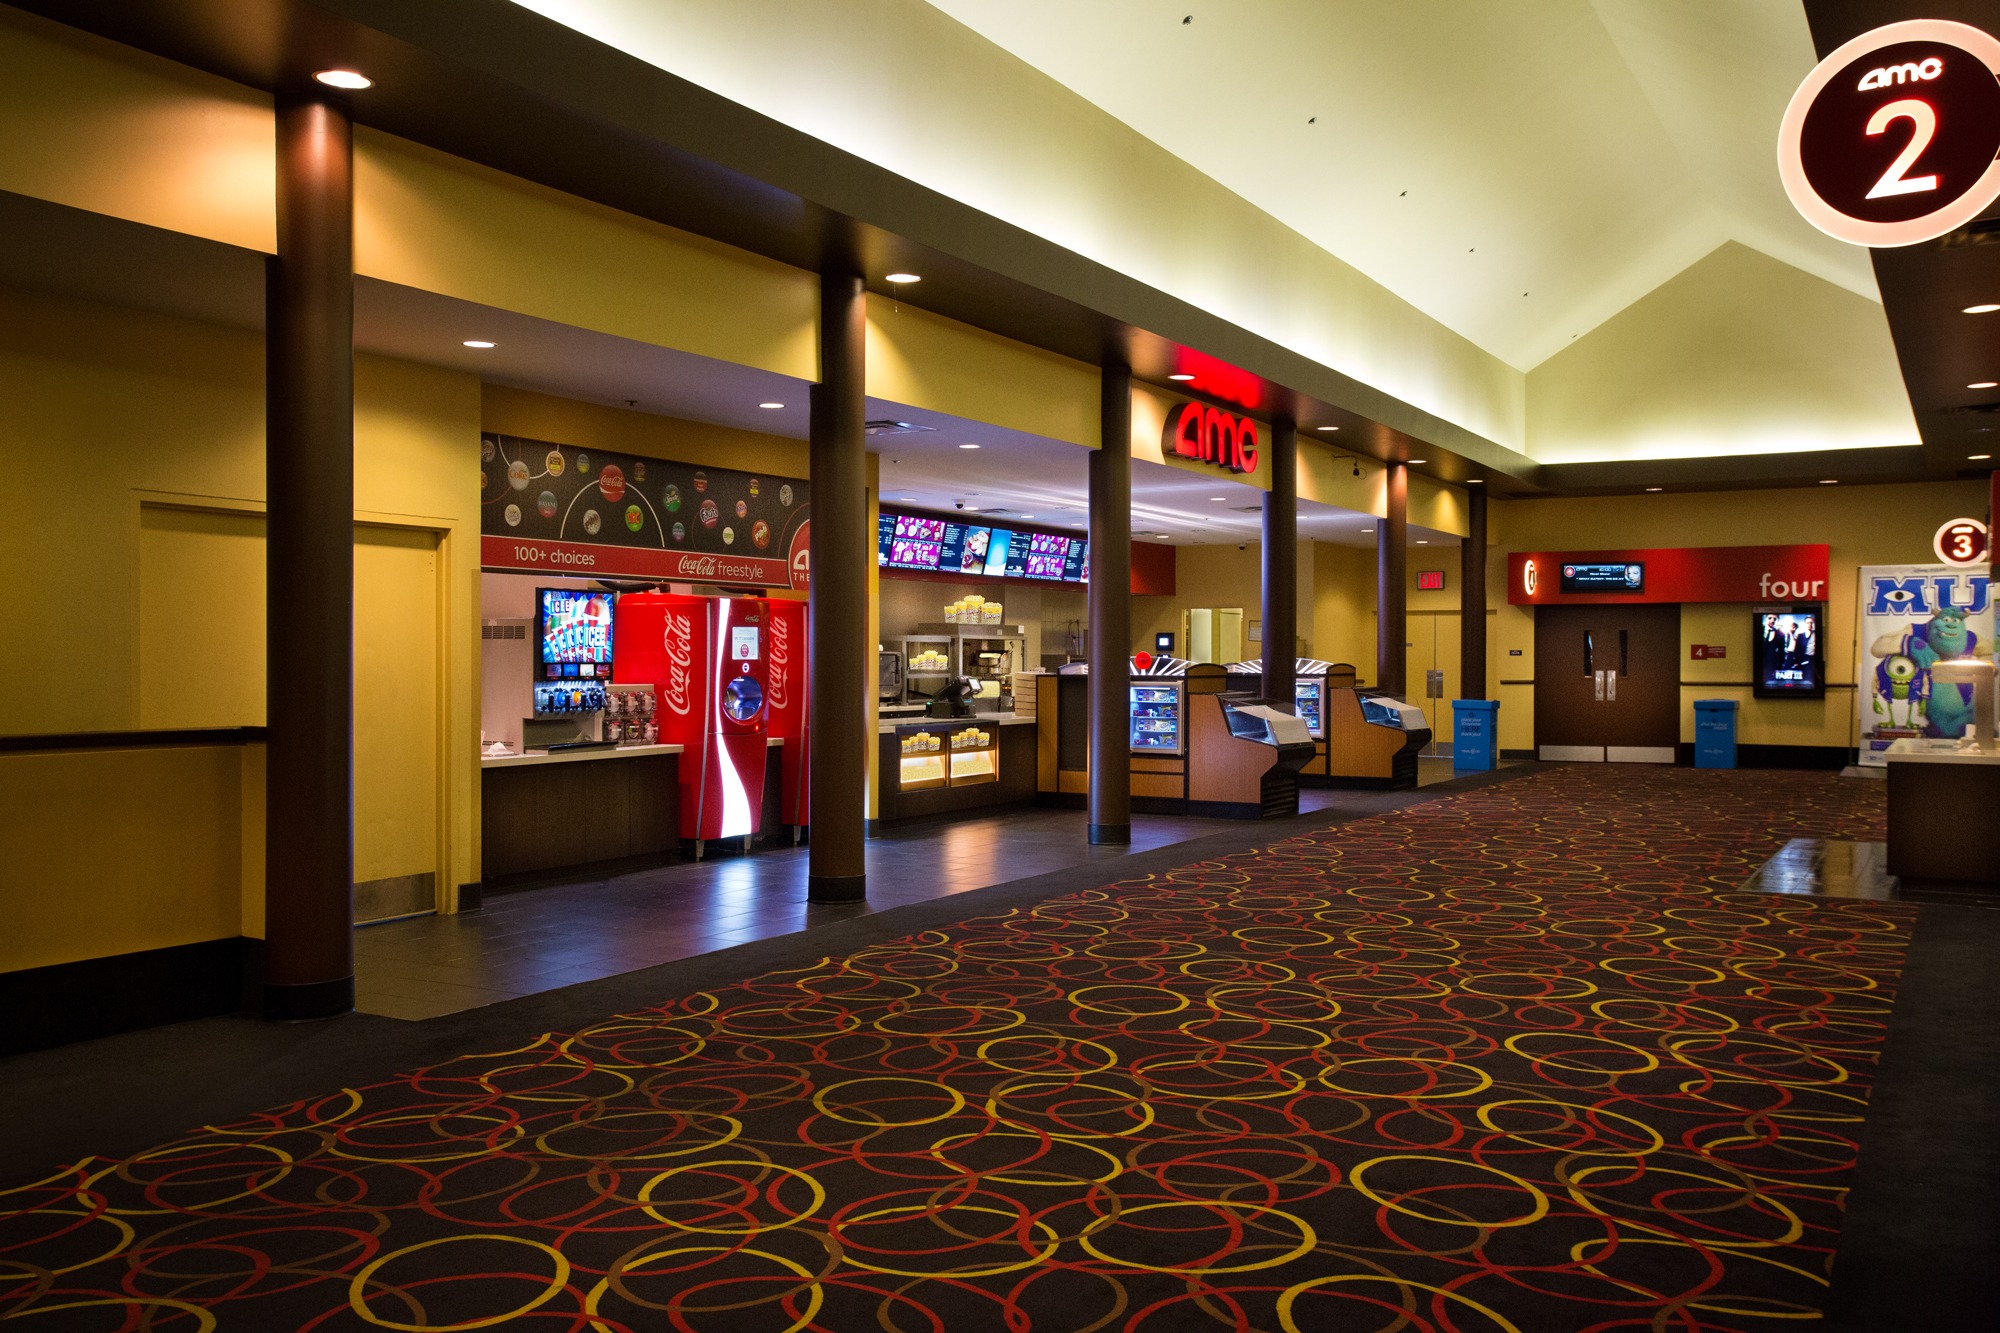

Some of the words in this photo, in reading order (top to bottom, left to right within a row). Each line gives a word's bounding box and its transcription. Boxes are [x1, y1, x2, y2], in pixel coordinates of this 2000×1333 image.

[1857, 58, 1943, 91] amc
[1865, 98, 1938, 200] 2
[1175, 401, 1259, 474] amc
[514, 546, 547, 562] 100+
[550, 549, 595, 566] choices
[1953, 534, 1973, 558] 3
[678, 555, 717, 576] Coca-Cola
[717, 561, 763, 580] freestyle
[1420, 572, 1441, 589] EXIT
[1759, 573, 1824, 598] four
[550, 600, 570, 614] ICEE
[585, 627, 605, 647] ICEE
[664, 608, 691, 716] Coca-Cola
[1695, 648, 1703, 657] 4
[1775, 671, 1793, 680] PART
